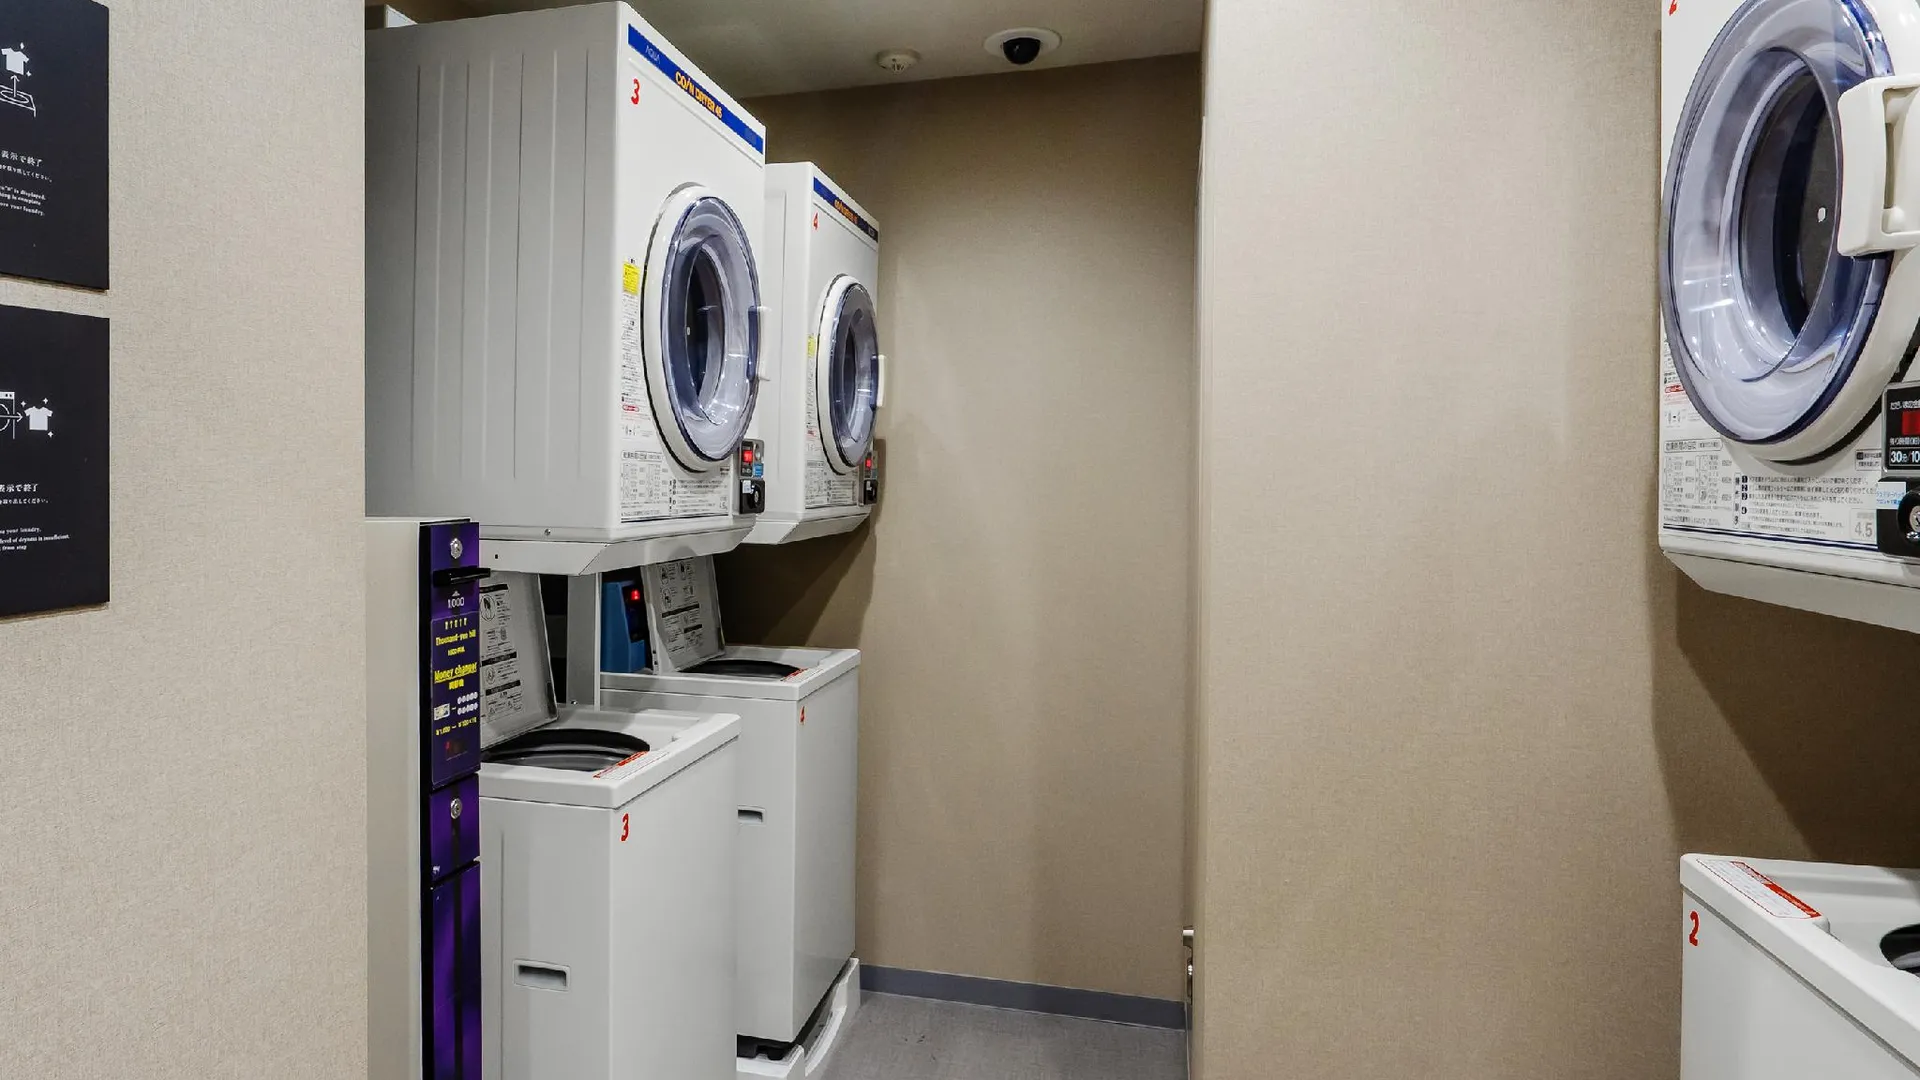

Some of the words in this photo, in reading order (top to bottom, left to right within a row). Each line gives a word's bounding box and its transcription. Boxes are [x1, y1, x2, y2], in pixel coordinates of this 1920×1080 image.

[630, 77, 641, 105] 3
[813, 212, 819, 231] 4
[434, 667, 454, 682] Money
[454, 661, 478, 675] changer
[620, 813, 630, 842] 3
[1688, 910, 1700, 947] 2
